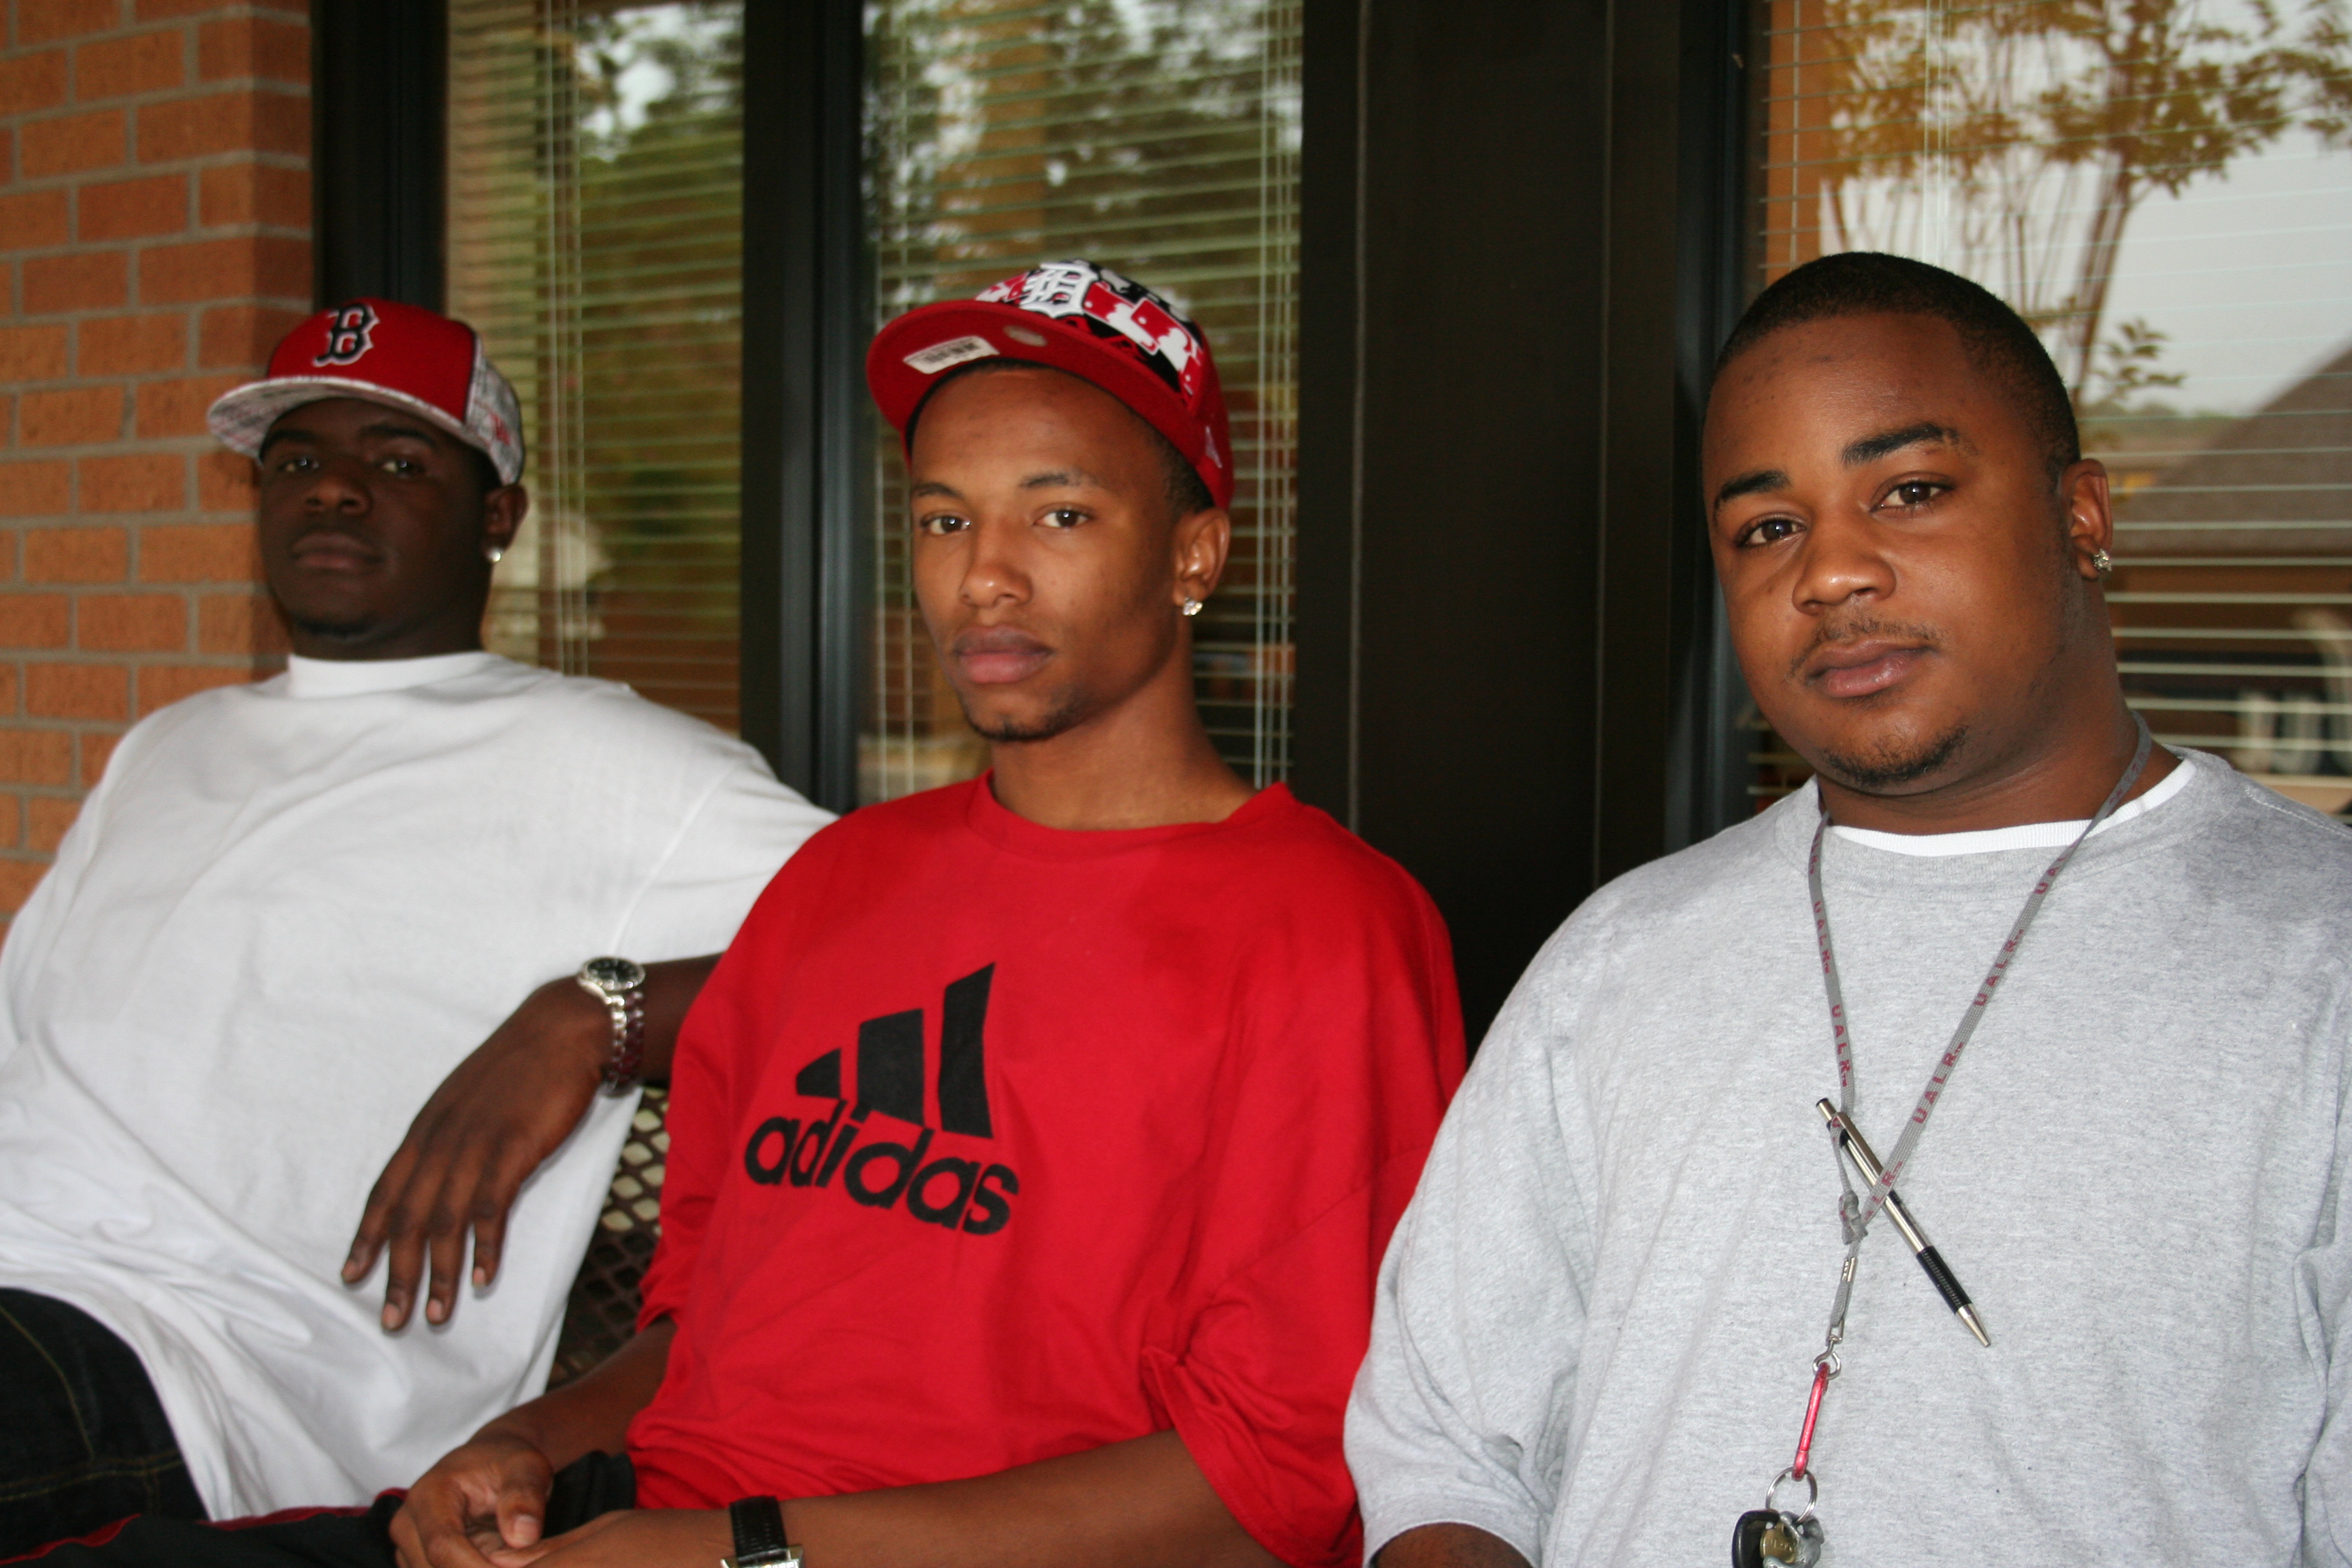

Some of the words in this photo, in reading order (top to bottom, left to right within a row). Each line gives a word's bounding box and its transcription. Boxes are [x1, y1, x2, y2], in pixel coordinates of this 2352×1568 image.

[312, 302, 380, 368] B
[1912, 1052, 1957, 1124] UALR
[745, 1099, 1019, 1235] adidas
